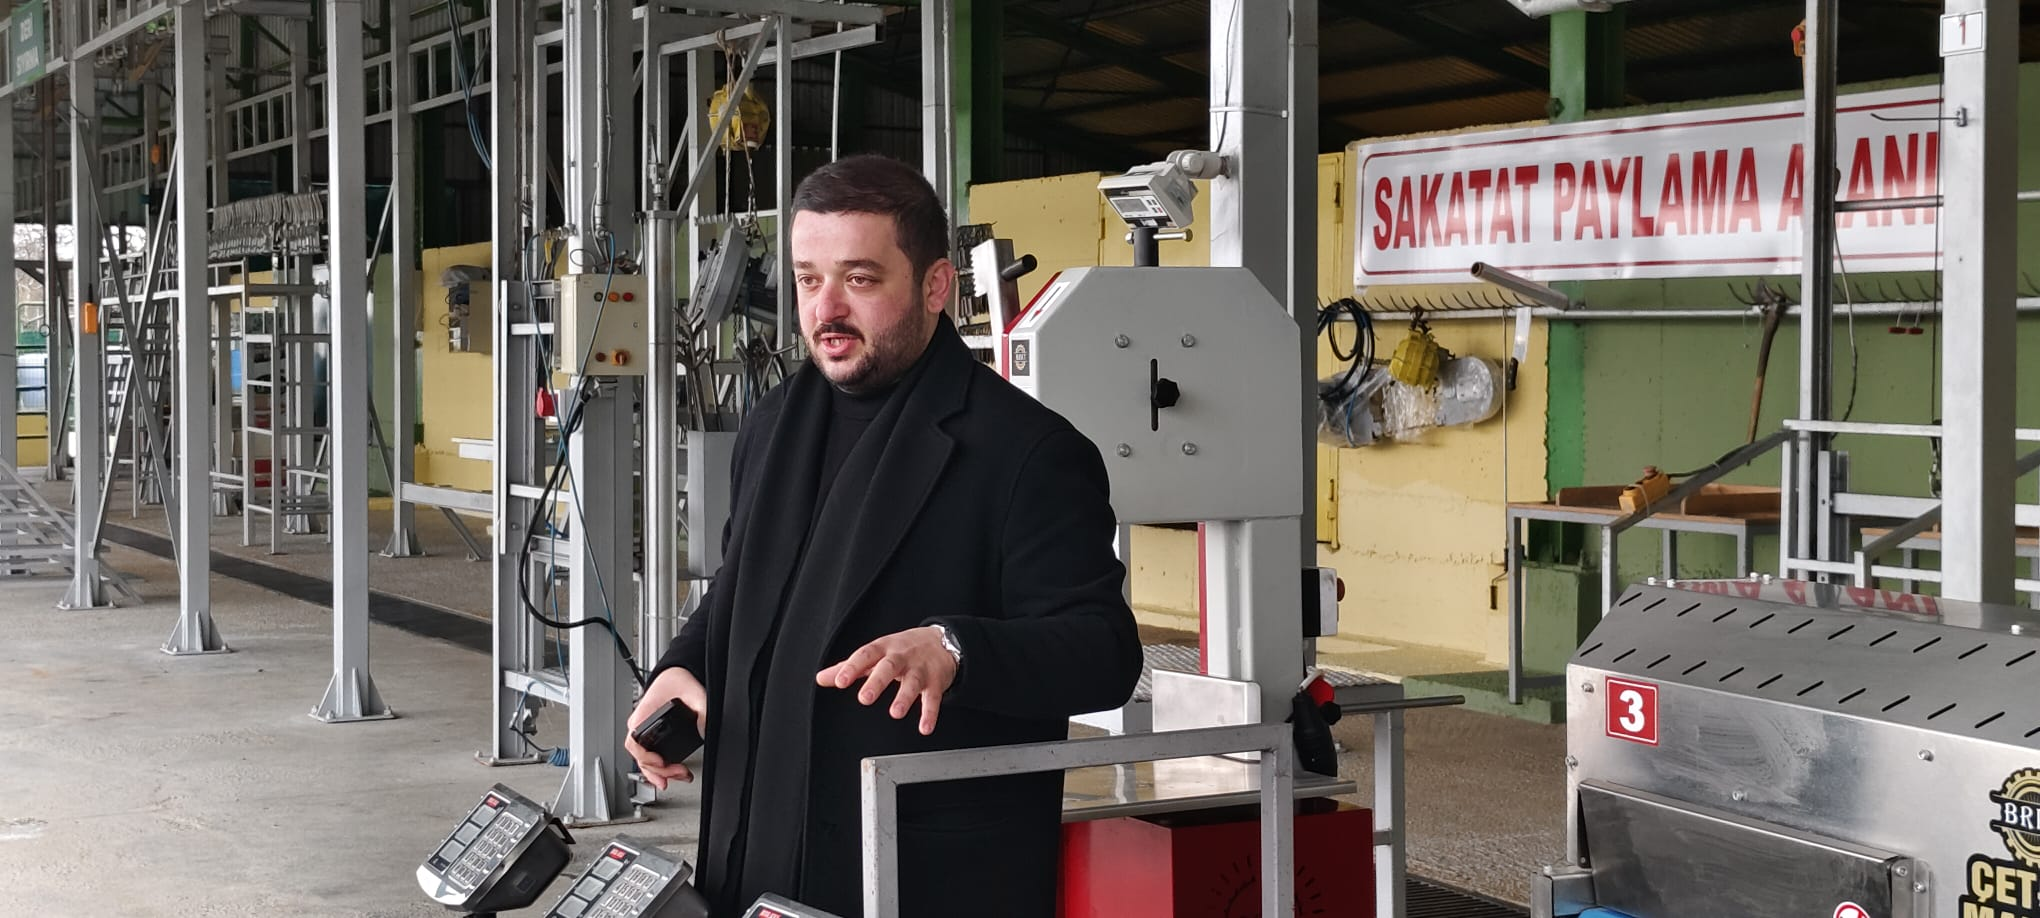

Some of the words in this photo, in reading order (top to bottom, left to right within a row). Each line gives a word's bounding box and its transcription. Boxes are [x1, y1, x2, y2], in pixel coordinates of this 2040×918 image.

[1958, 17, 1967, 46] 1
[1373, 164, 1539, 251] SAKATAT
[1553, 147, 1762, 243] PAYLAMA
[1777, 131, 1938, 232] AANI
[1619, 689, 1645, 733] 3
